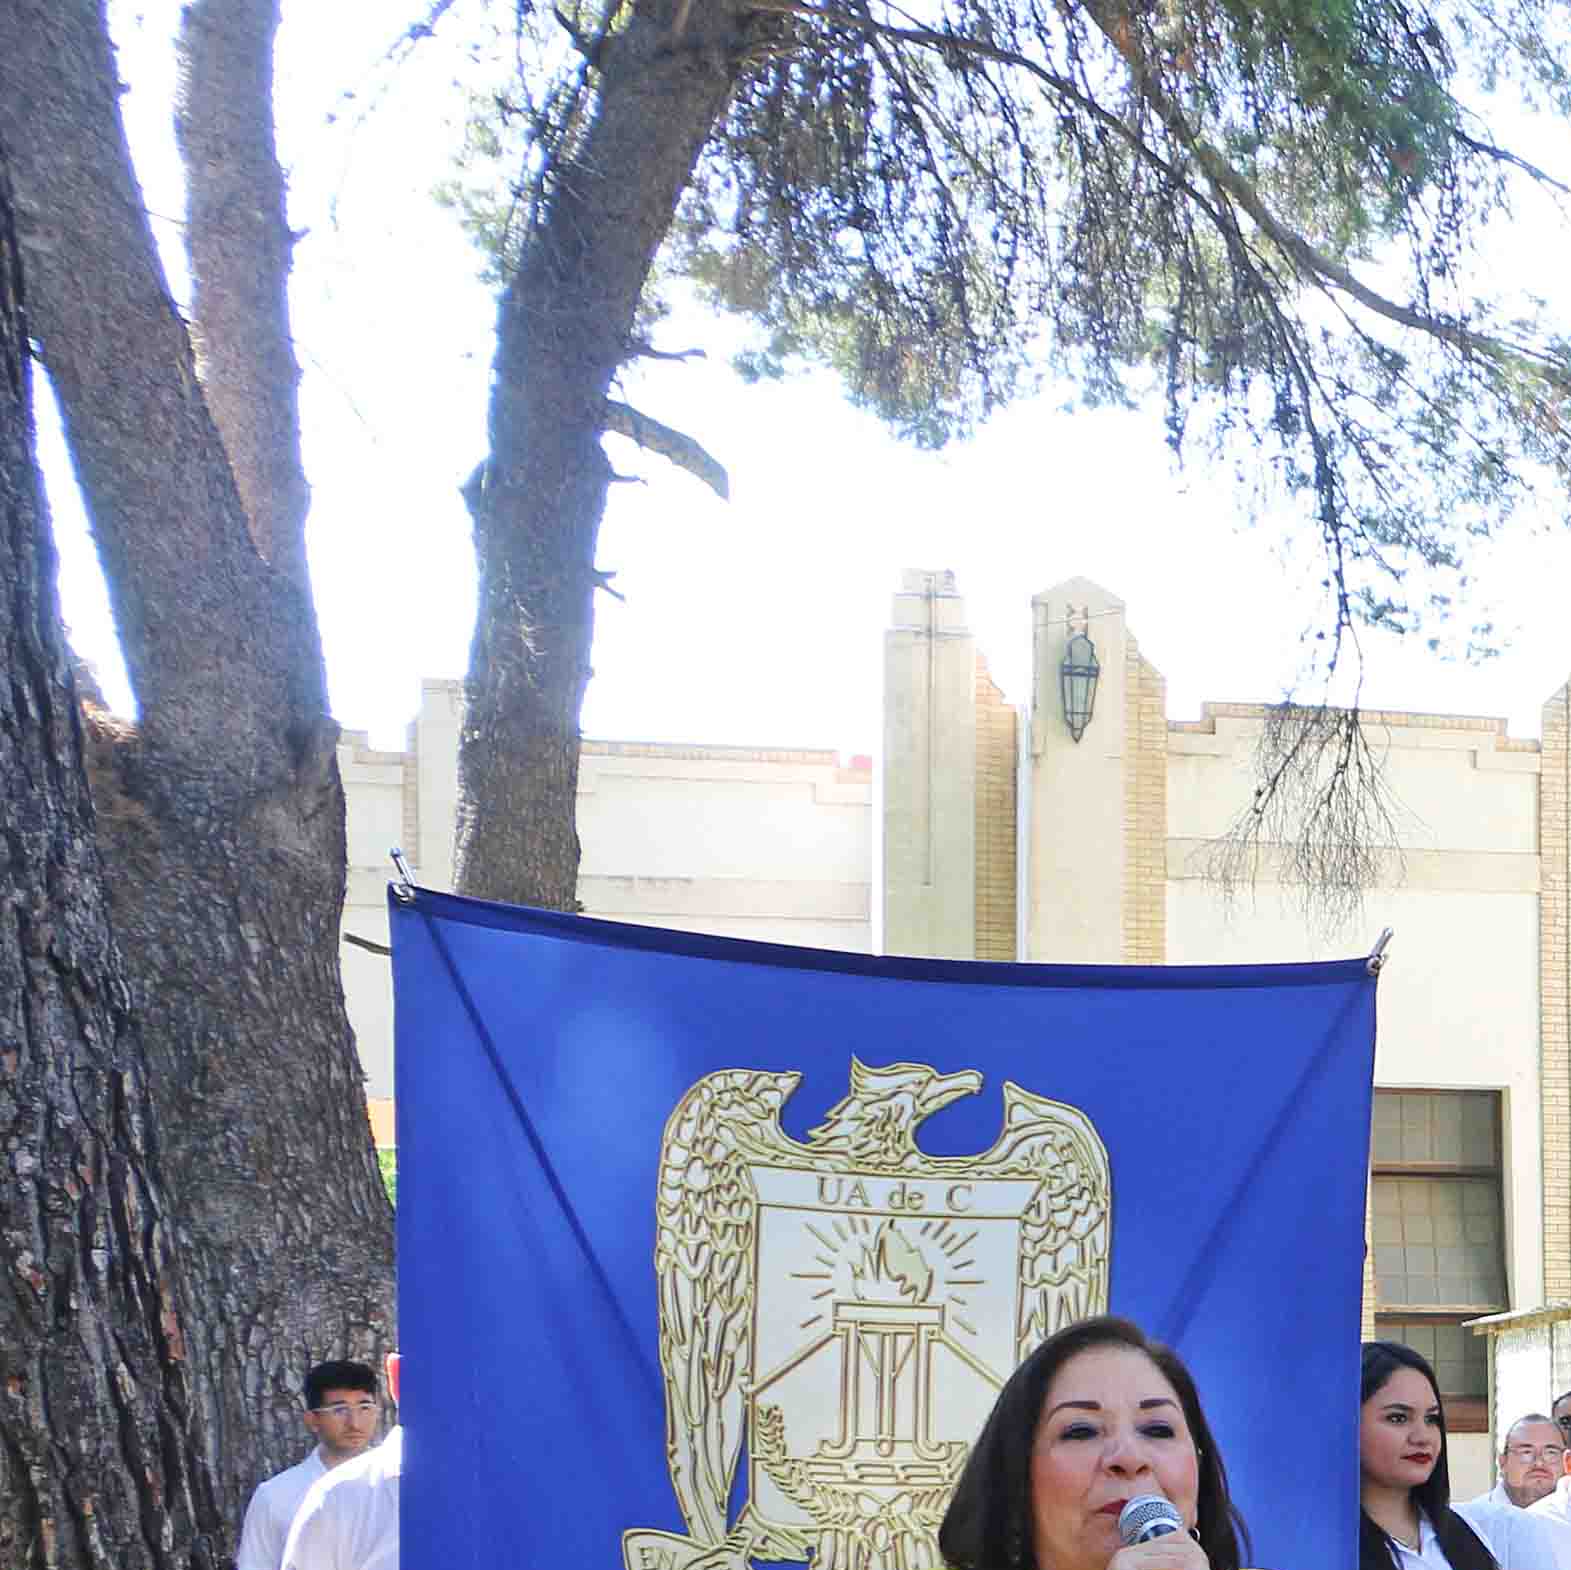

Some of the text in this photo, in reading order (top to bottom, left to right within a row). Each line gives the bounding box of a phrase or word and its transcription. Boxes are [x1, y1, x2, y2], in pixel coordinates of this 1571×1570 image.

[815, 1175, 974, 1213] UA de C
